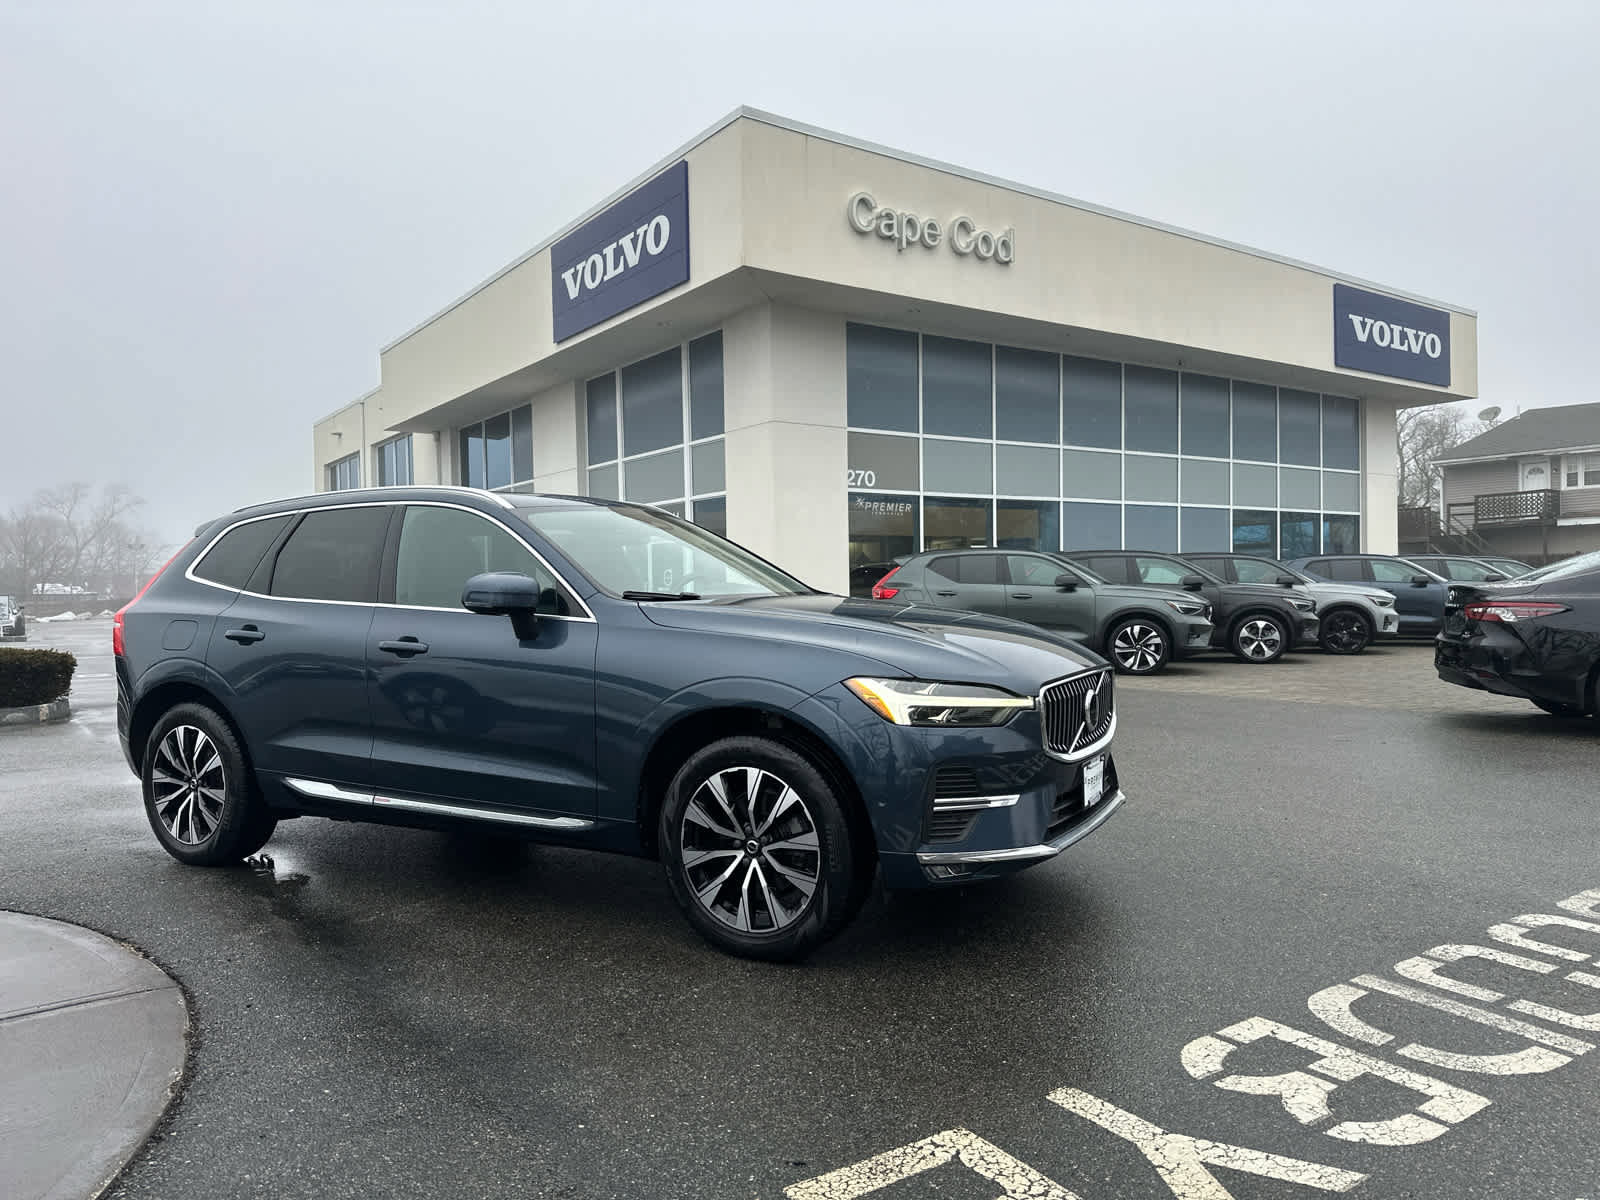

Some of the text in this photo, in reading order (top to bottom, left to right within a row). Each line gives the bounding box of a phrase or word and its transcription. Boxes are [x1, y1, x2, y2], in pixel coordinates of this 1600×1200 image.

[848, 193, 1016, 265] Cape Cod
[562, 214, 670, 300] VOLVO
[1348, 314, 1442, 359] VOLVO
[848, 470, 876, 487] 270
[864, 502, 912, 513] PREMIER
